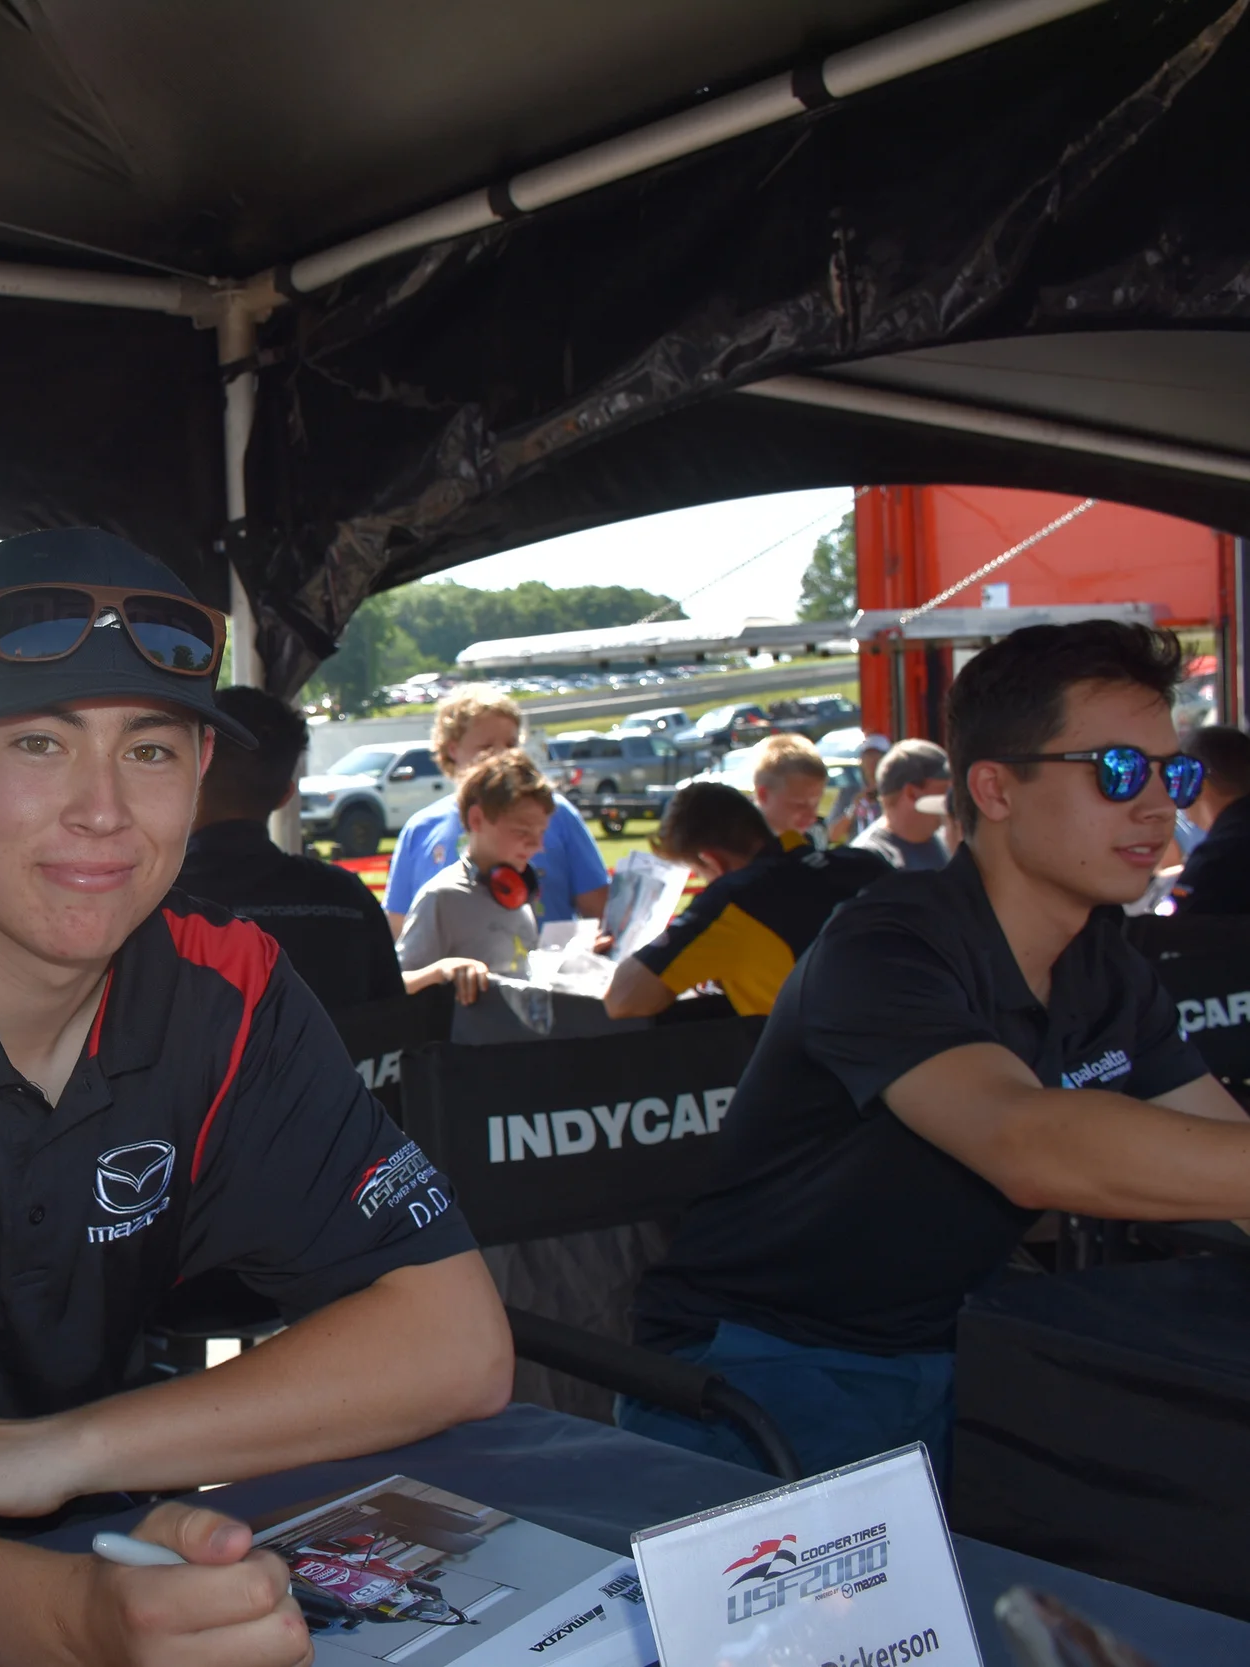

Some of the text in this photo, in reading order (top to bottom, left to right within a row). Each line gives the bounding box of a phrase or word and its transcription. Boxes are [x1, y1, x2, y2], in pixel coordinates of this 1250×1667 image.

[801, 1522, 887, 1562] COOPER TIRES
[727, 1541, 889, 1625] USF2000
[821, 1628, 940, 1667] kerson
